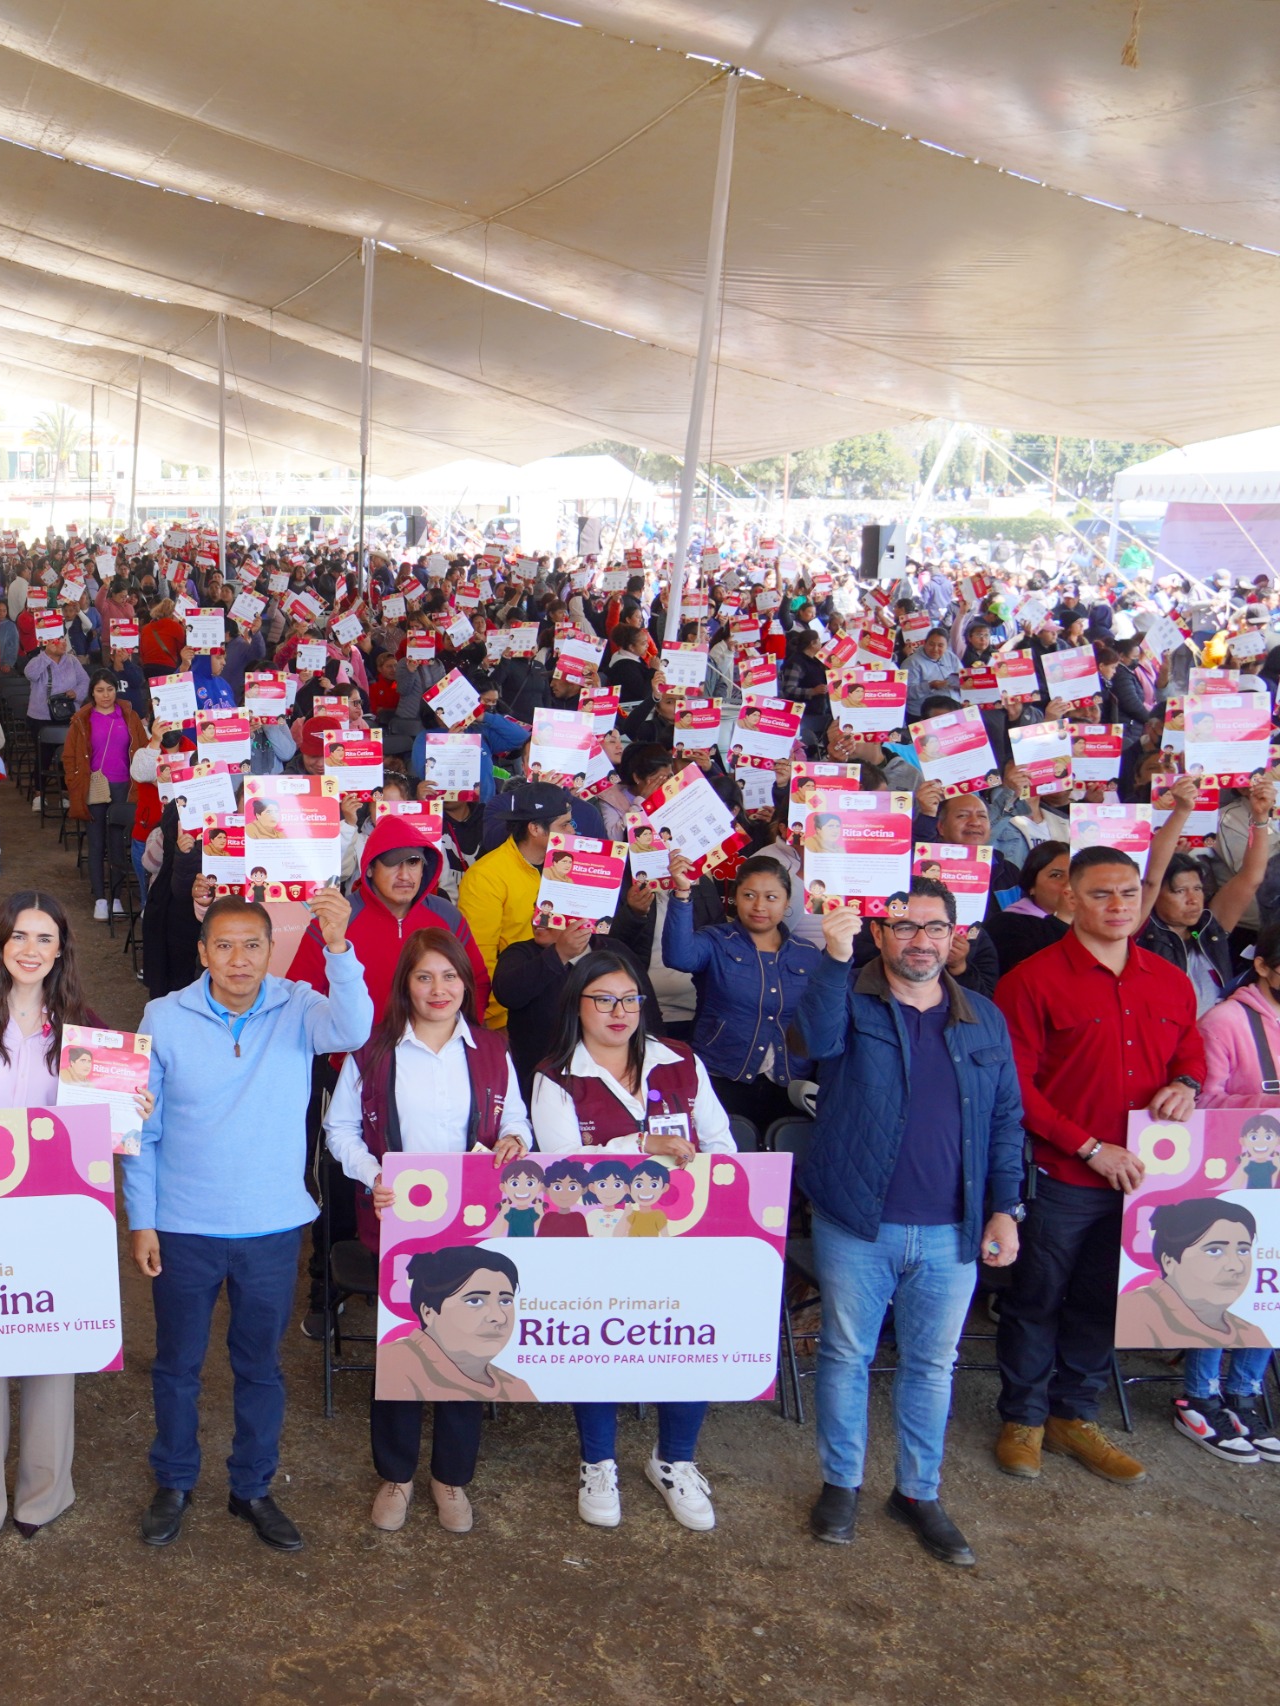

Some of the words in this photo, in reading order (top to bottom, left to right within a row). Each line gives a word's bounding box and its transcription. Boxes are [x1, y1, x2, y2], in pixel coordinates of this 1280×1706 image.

[281, 812, 299, 822] Rita
[300, 812, 327, 822] Cetina
[842, 828, 862, 837] Rita
[863, 828, 895, 838] Cetina
[572, 864, 587, 872] Rita
[587, 866, 611, 876] Cetina
[92, 1064, 109, 1074] Rita
[110, 1066, 137, 1077] Cetina
[519, 1297, 603, 1311] Educación
[608, 1297, 680, 1311] Primaria
[63, 1321, 71, 1331] Y
[74, 1317, 116, 1330] ÚTILES
[518, 1318, 590, 1346] Rita
[600, 1316, 716, 1346] Cetina
[517, 1354, 548, 1364] BECA
[550, 1354, 566, 1364] DE
[568, 1354, 610, 1364] APOYO
[613, 1354, 645, 1363] PARA
[648, 1353, 719, 1363] UNIFORMES
[721, 1353, 729, 1363] Y
[732, 1350, 772, 1363] ÚTILES
